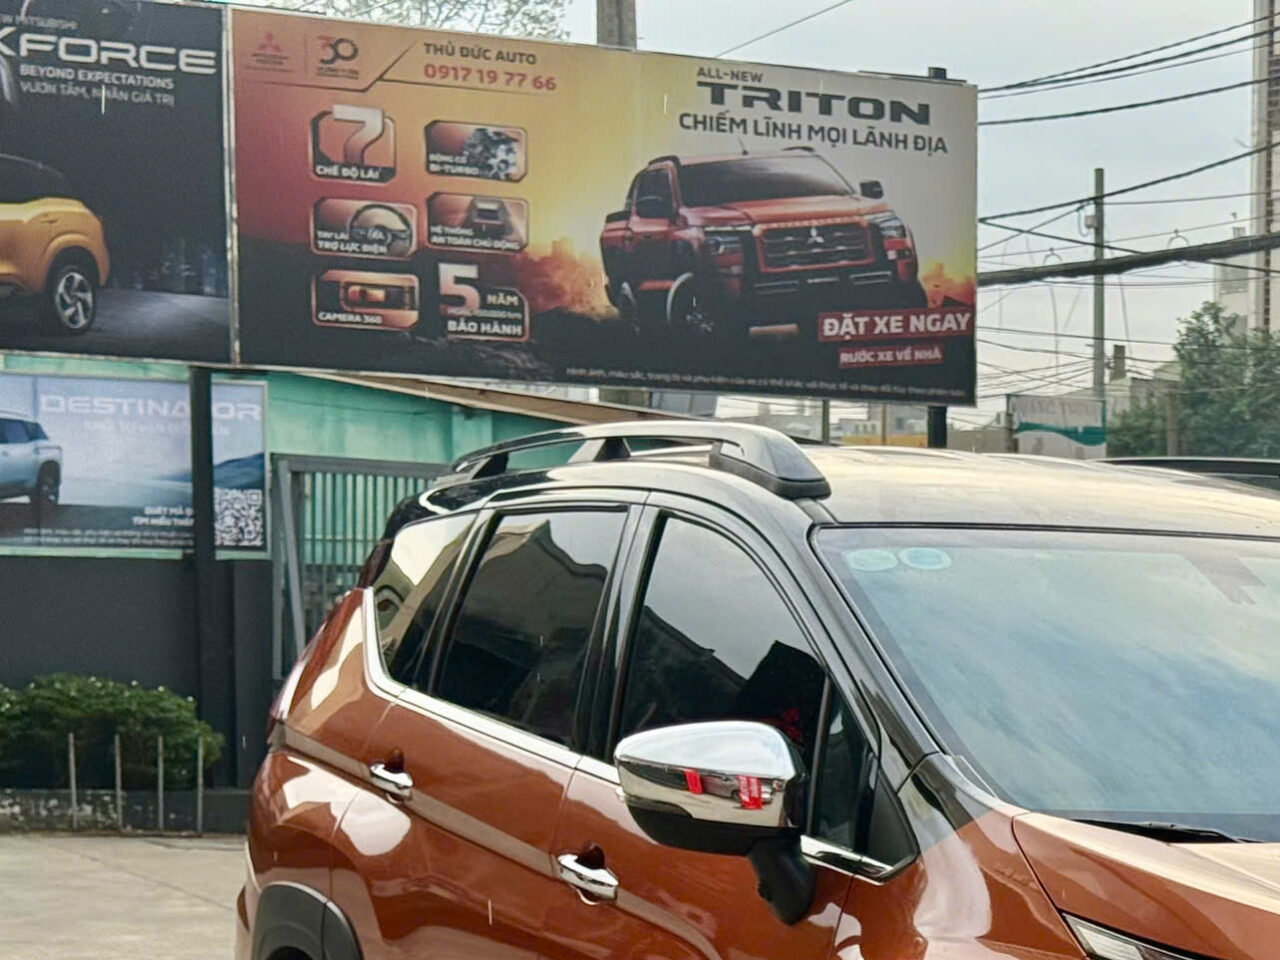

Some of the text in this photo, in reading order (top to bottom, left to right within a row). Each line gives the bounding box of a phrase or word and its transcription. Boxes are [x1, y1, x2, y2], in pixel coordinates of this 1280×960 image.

[423, 41, 537, 65] THỦ ĐỨC AUTO
[20, 64, 174, 89] BEYOND EXPECTATIONS
[424, 63, 557, 91] 0917 19 77 66
[697, 66, 763, 83] ALL-NEW
[697, 81, 931, 126] TRITON
[332, 103, 385, 165] 7
[679, 109, 948, 156] CHIẾM LĨNH MỌI LÃNH ĐỊA
[438, 263, 480, 316] 5
[487, 292, 519, 306] NĂM
[447, 318, 522, 336] BẢO HÀNH
[822, 312, 971, 340] ĐẶT XE NGAY
[877, 350, 894, 362] XE
[39, 393, 263, 421] DESTINAOR
